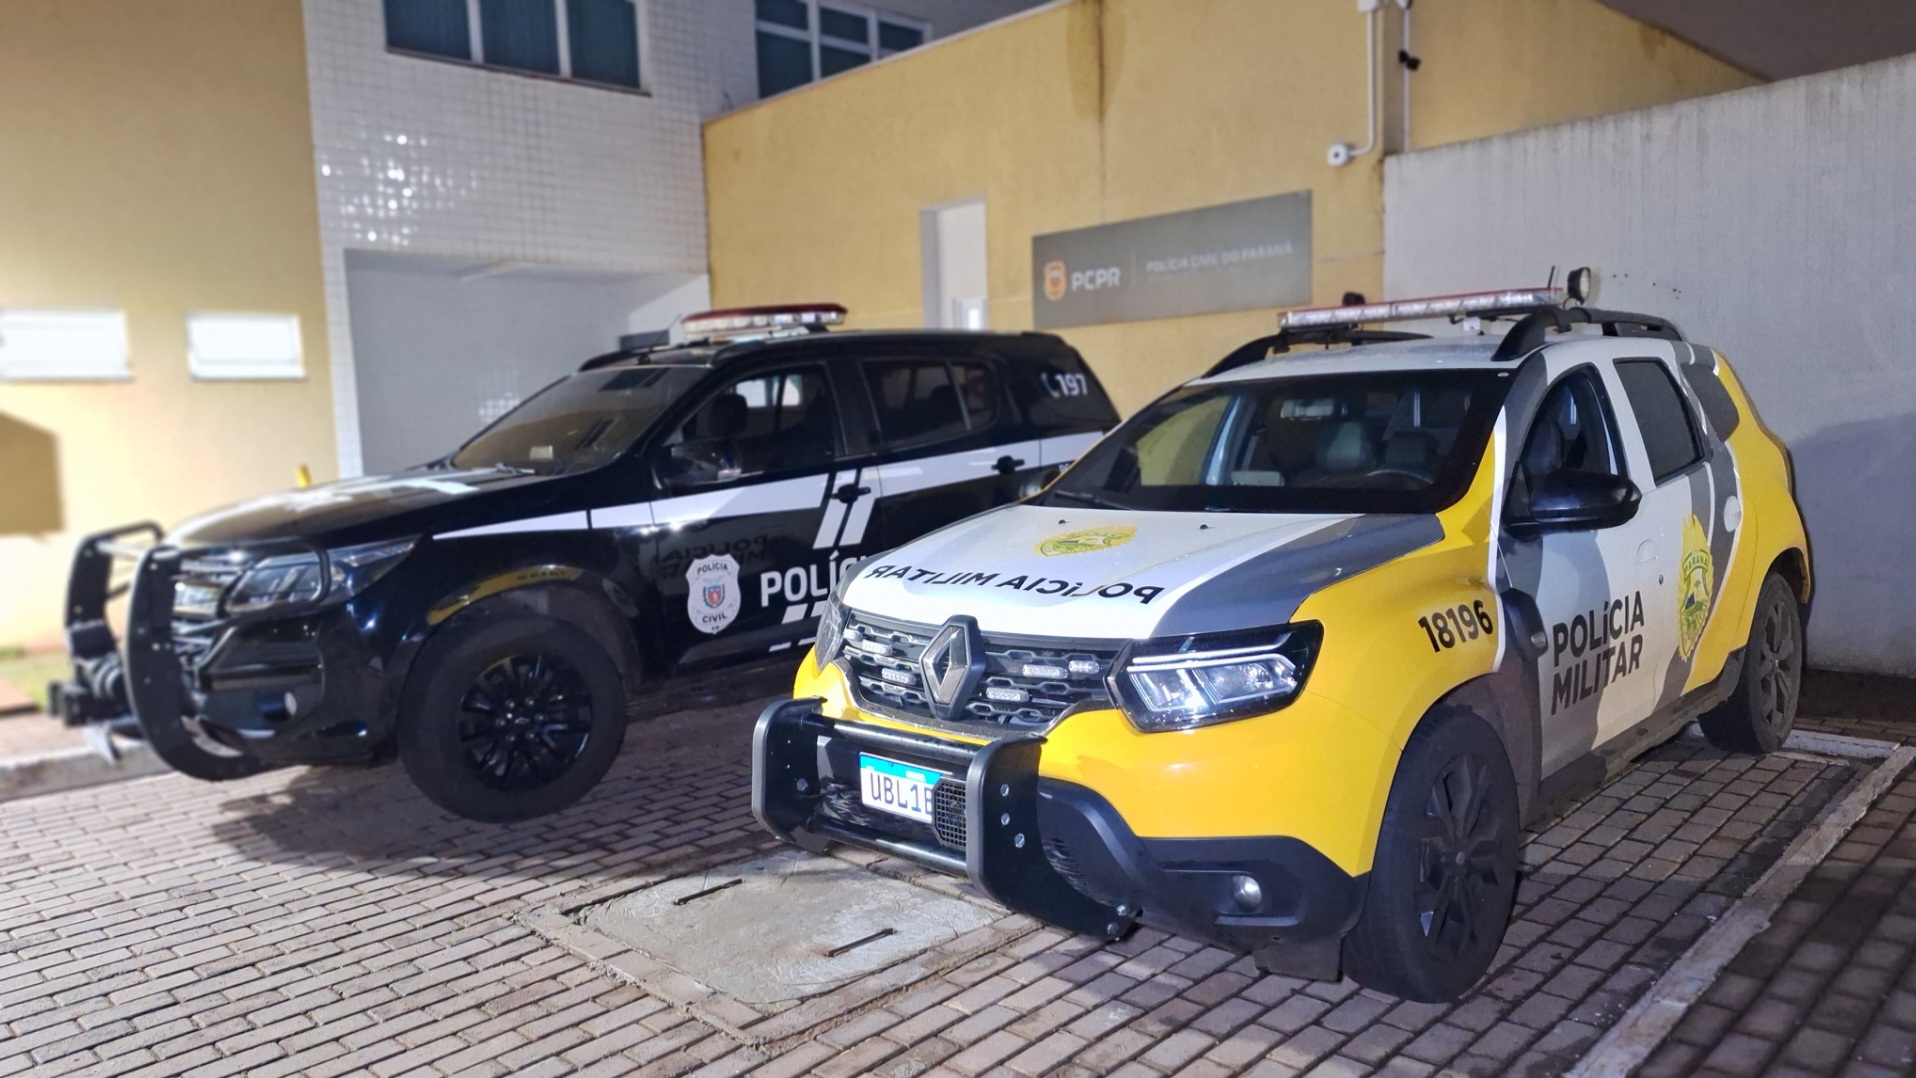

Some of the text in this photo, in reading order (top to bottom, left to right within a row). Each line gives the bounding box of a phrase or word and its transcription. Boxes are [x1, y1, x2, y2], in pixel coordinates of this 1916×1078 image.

[1071, 267, 1121, 291] PCPR
[1055, 373, 1088, 396] 197
[702, 612, 727, 624] CIVIL
[1418, 599, 1494, 653] 18196
[1551, 633, 1643, 716] MILITAR
